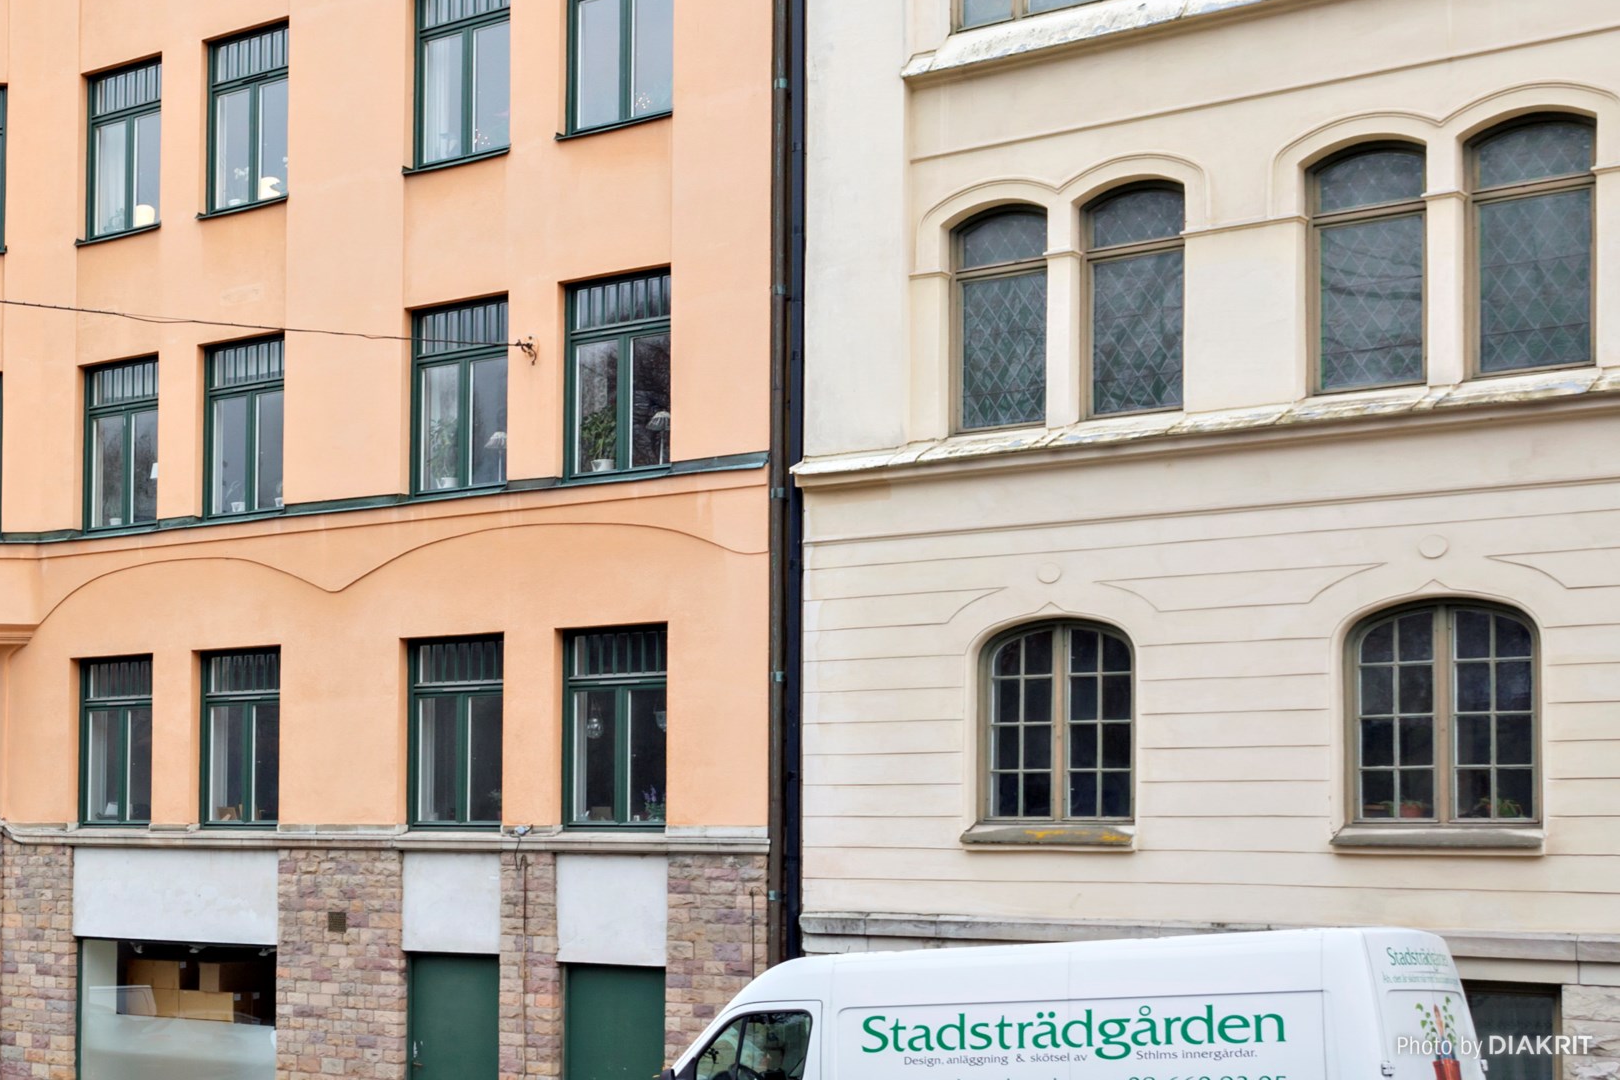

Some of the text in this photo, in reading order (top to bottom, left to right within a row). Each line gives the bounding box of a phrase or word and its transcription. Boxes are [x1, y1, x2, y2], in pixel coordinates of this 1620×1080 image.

[861, 1004, 1286, 1060] Stadsträdgården
[947, 1054, 1009, 1066] anläggning
[1016, 1053, 1026, 1063] &
[1030, 1052, 1070, 1063] skötsel
[1074, 1053, 1088, 1062] av
[1136, 1049, 1179, 1060] Sthlms
[1181, 1048, 1258, 1061] innergårdar.
